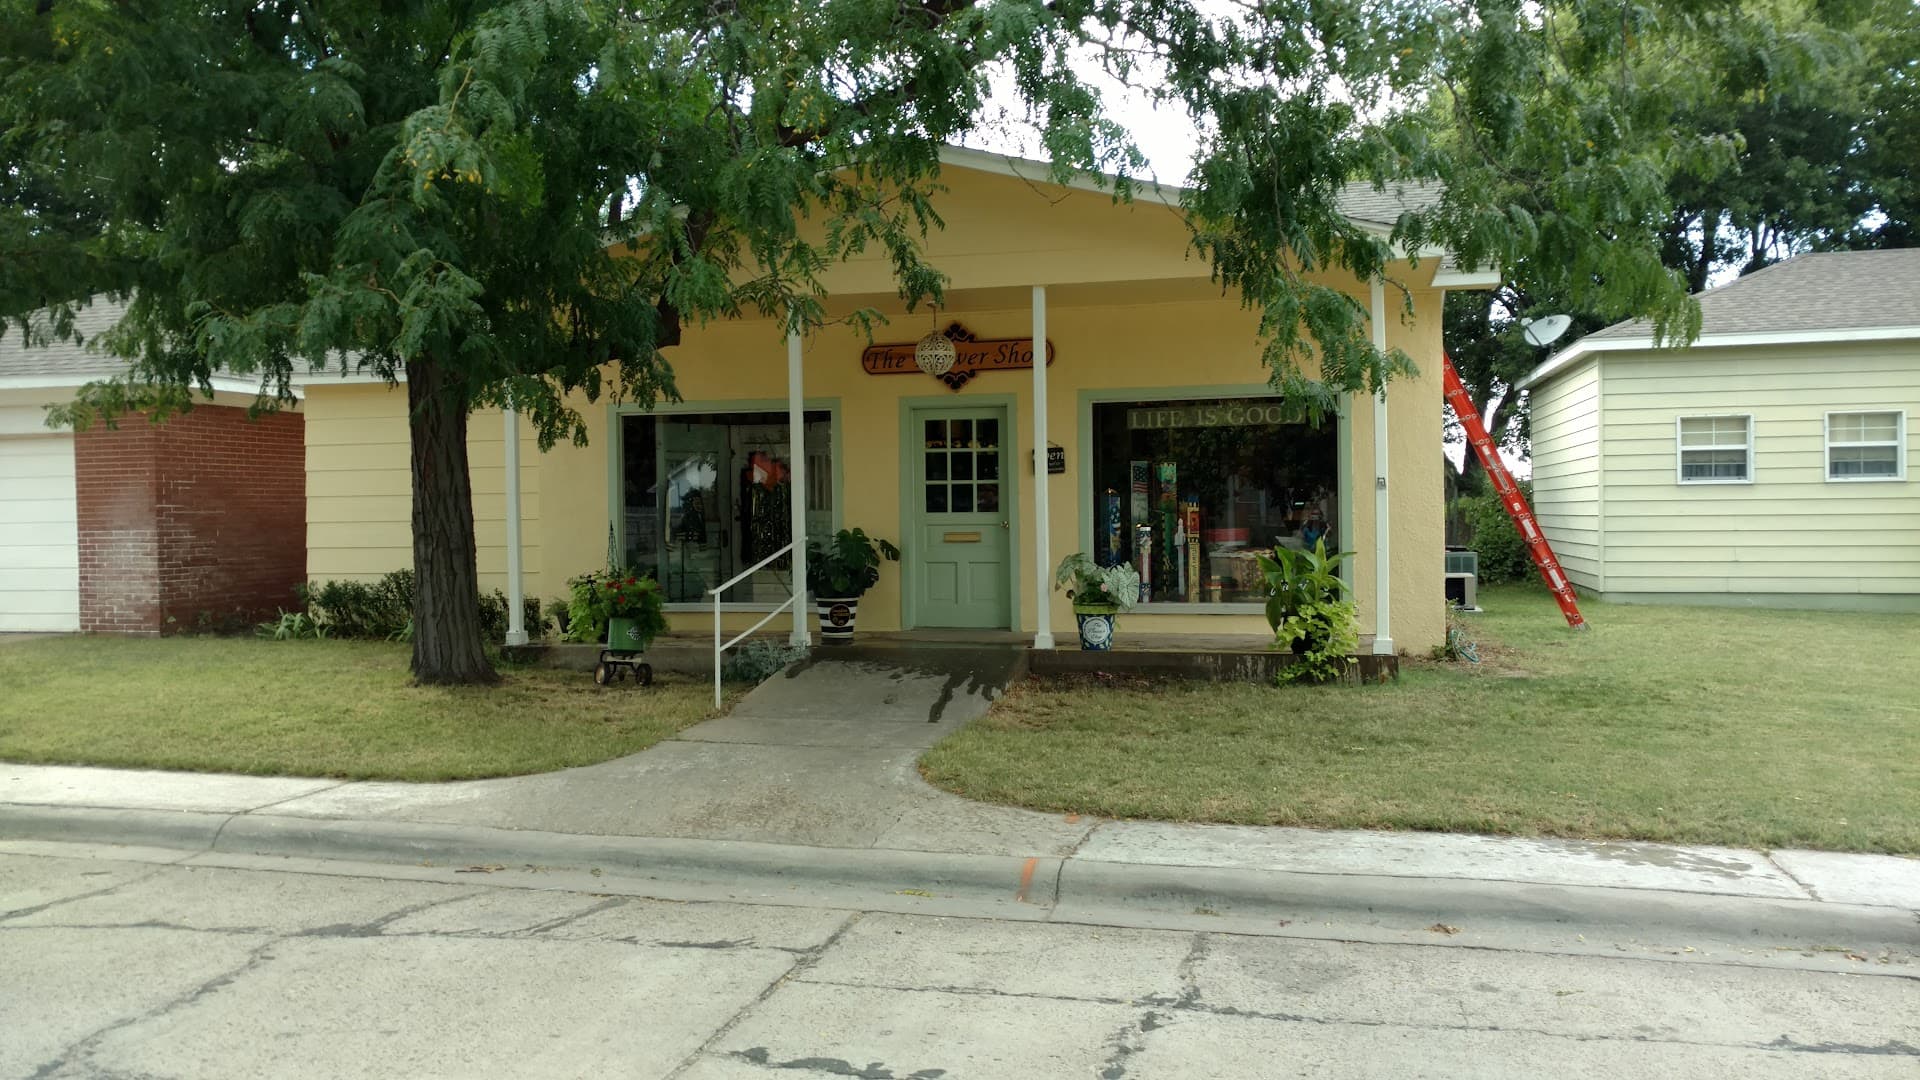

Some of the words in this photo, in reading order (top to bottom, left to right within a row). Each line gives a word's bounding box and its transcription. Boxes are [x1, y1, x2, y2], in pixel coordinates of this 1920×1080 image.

[870, 349, 906, 369] The
[994, 342, 1036, 364] Sho
[1131, 410, 1183, 428] LIFE
[1196, 408, 1217, 426] IS
